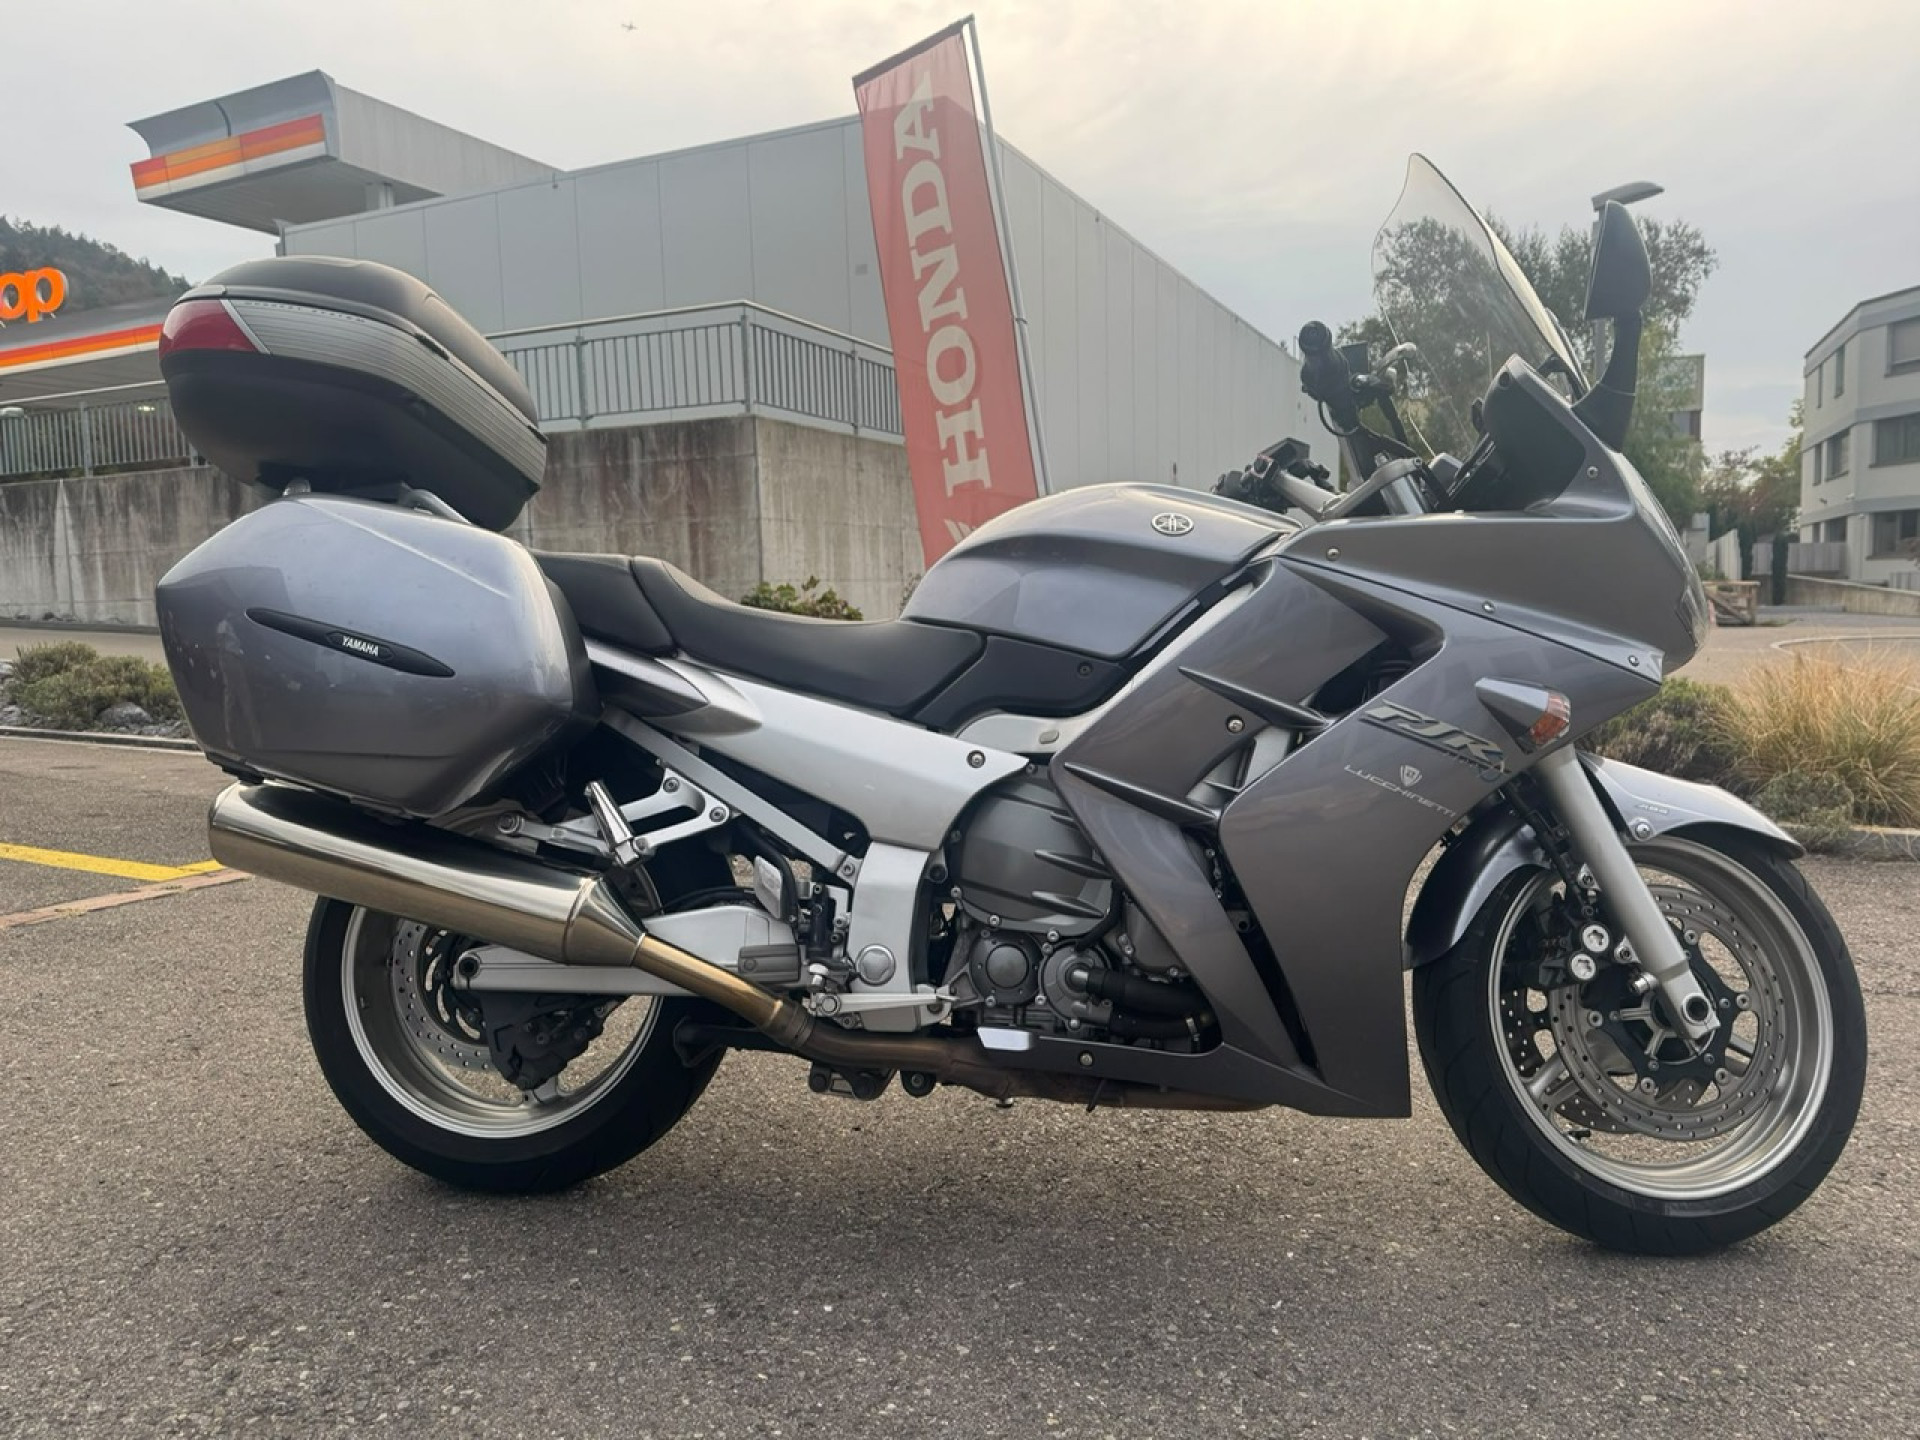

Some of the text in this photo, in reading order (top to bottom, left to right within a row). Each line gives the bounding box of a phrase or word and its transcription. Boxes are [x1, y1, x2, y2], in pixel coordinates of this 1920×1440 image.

[894, 72, 992, 497] HONDA
[342, 635, 379, 657] YAMAHA
[1364, 698, 1504, 765] FJR
